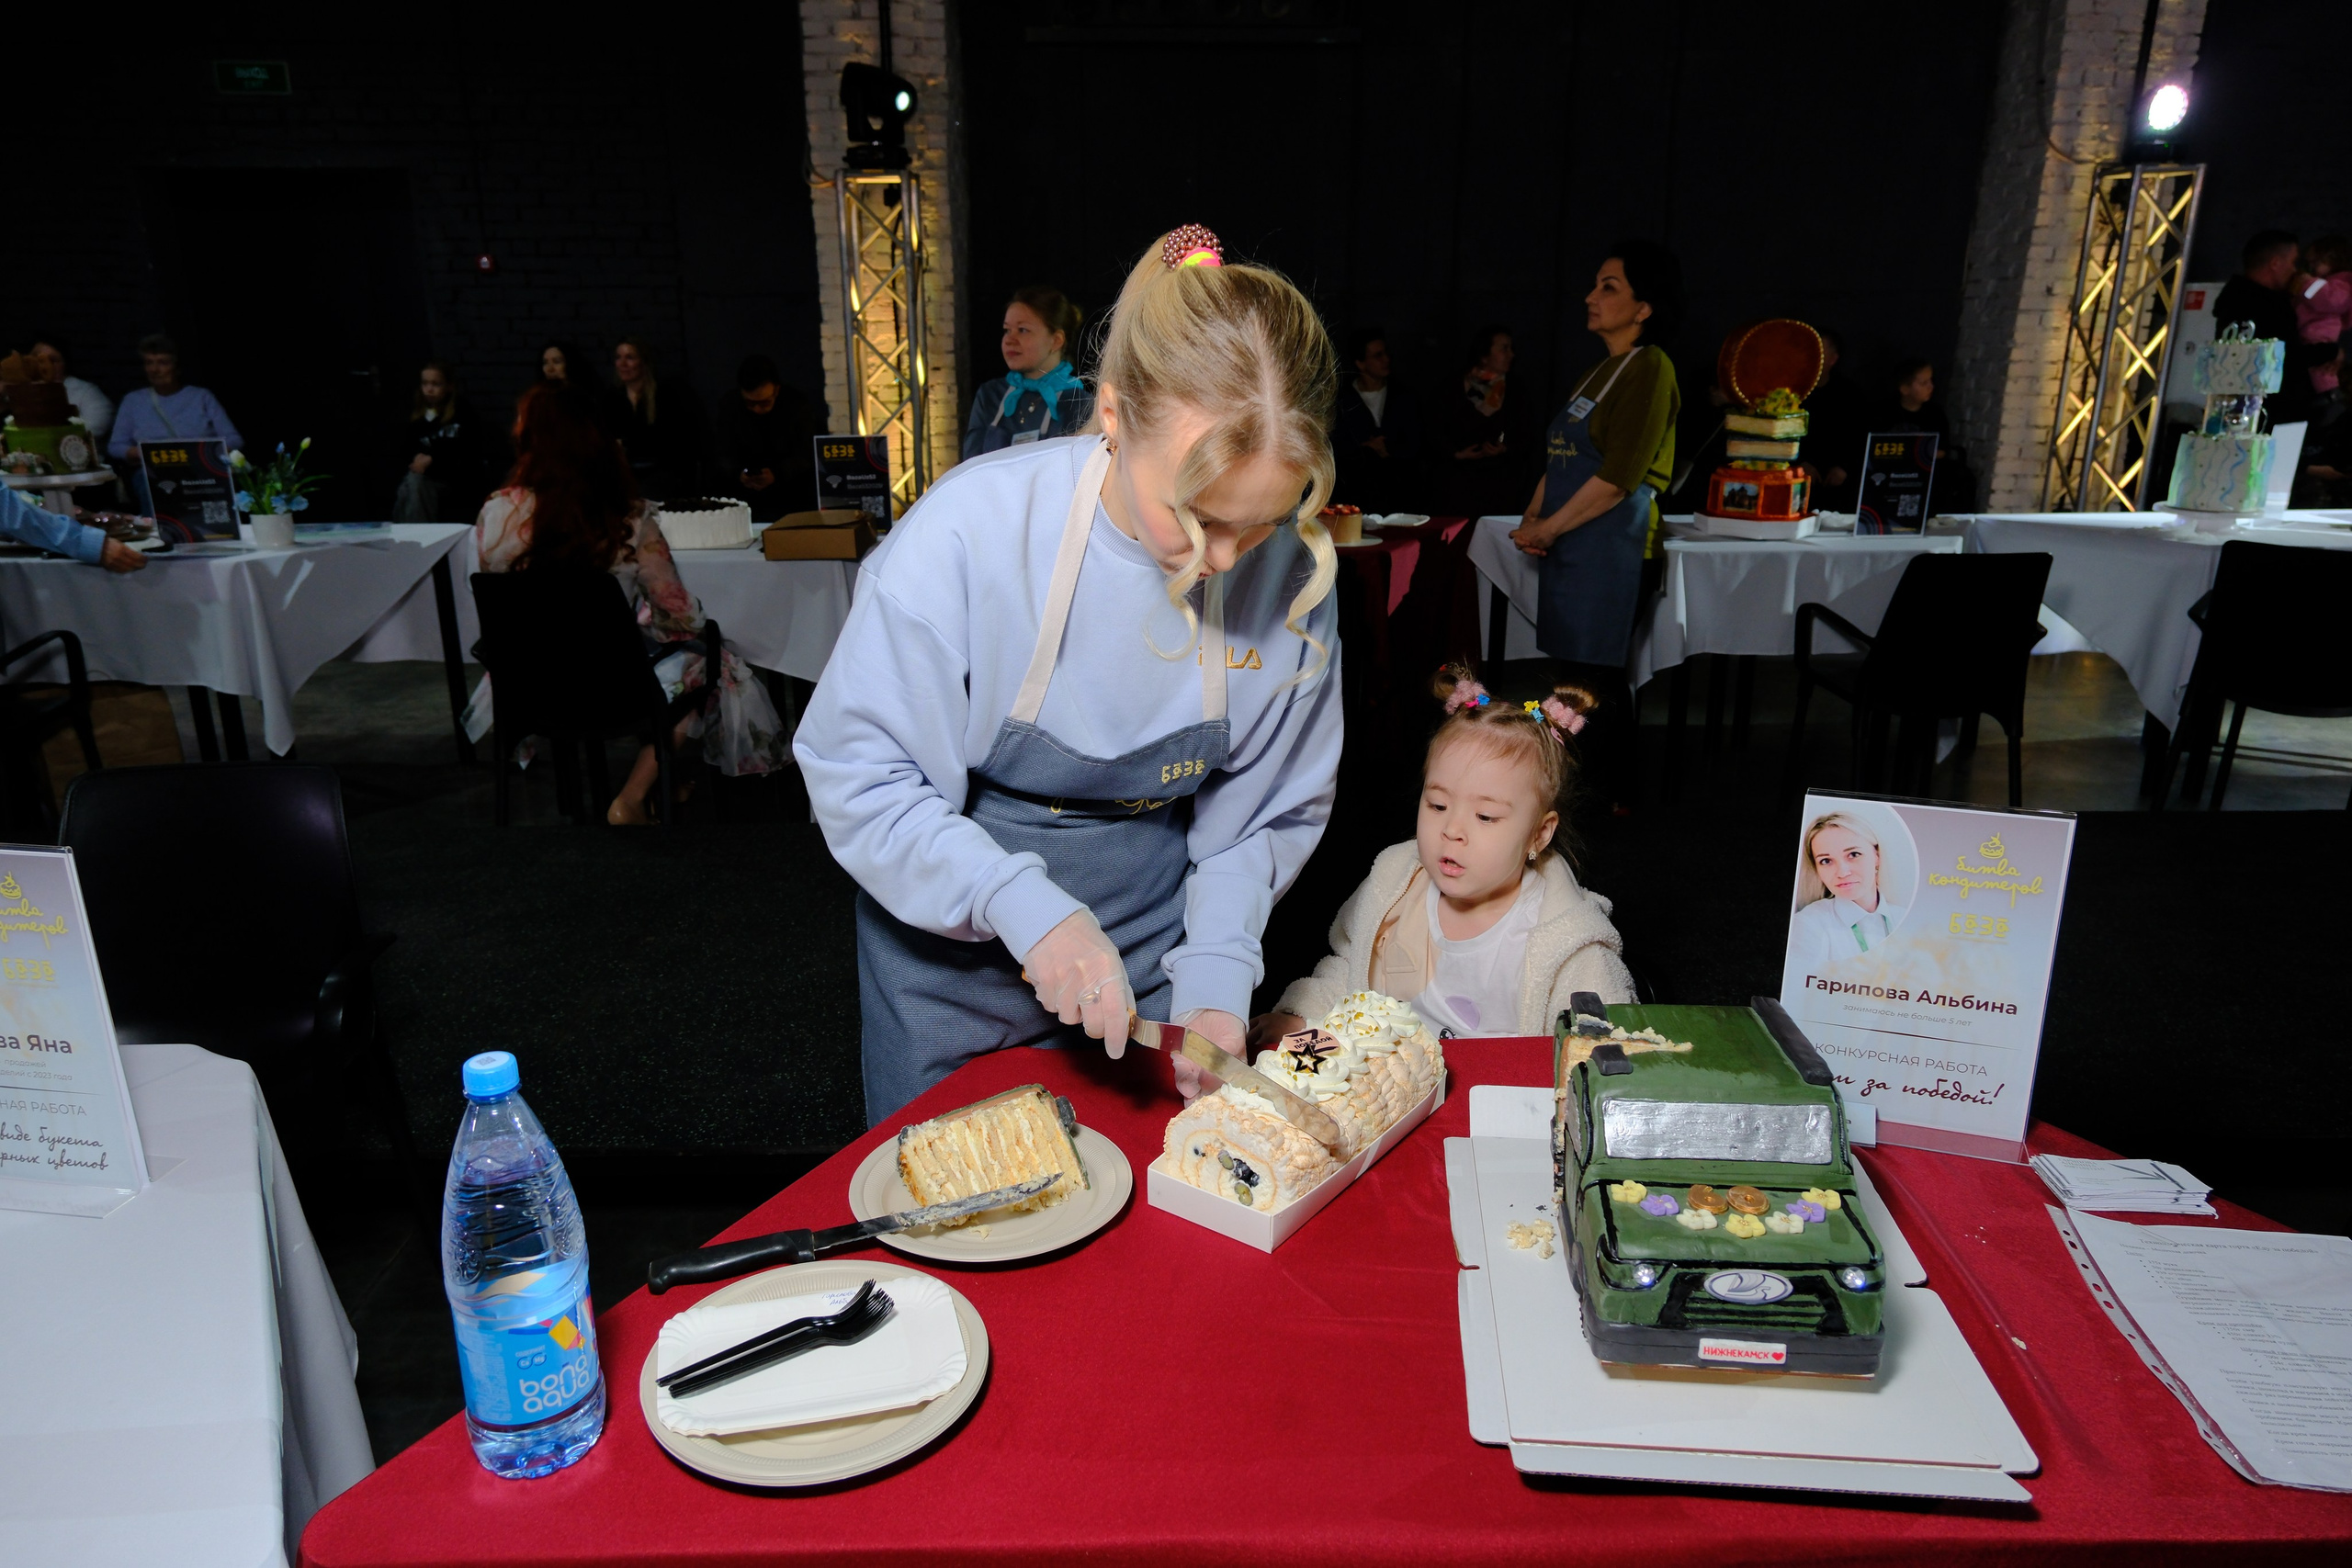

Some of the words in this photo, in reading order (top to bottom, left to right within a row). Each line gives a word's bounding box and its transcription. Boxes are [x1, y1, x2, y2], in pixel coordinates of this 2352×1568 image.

[1804, 975, 1910, 1002] Гарипова
[1916, 989, 2018, 1015] Альбина
[1842, 1003, 1894, 1017] занимаюсь
[1911, 1011, 1946, 1024] больше
[27, 1034, 73, 1054] Яна
[1815, 1043, 1920, 1066] КОНКУРСНАЯ
[1925, 1058, 1988, 1077] РАБОТА
[33, 1071, 51, 1079] 2023
[53, 1073, 73, 1081] года
[1860, 1078, 1892, 1097] за
[1902, 1078, 2005, 1105] победой!
[30, 1101, 87, 1116] РАБОТА
[39, 1126, 104, 1152] букета
[48, 1148, 108, 1171] цветов
[1703, 1346, 1770, 1359] НИЖНЕКАМСК
